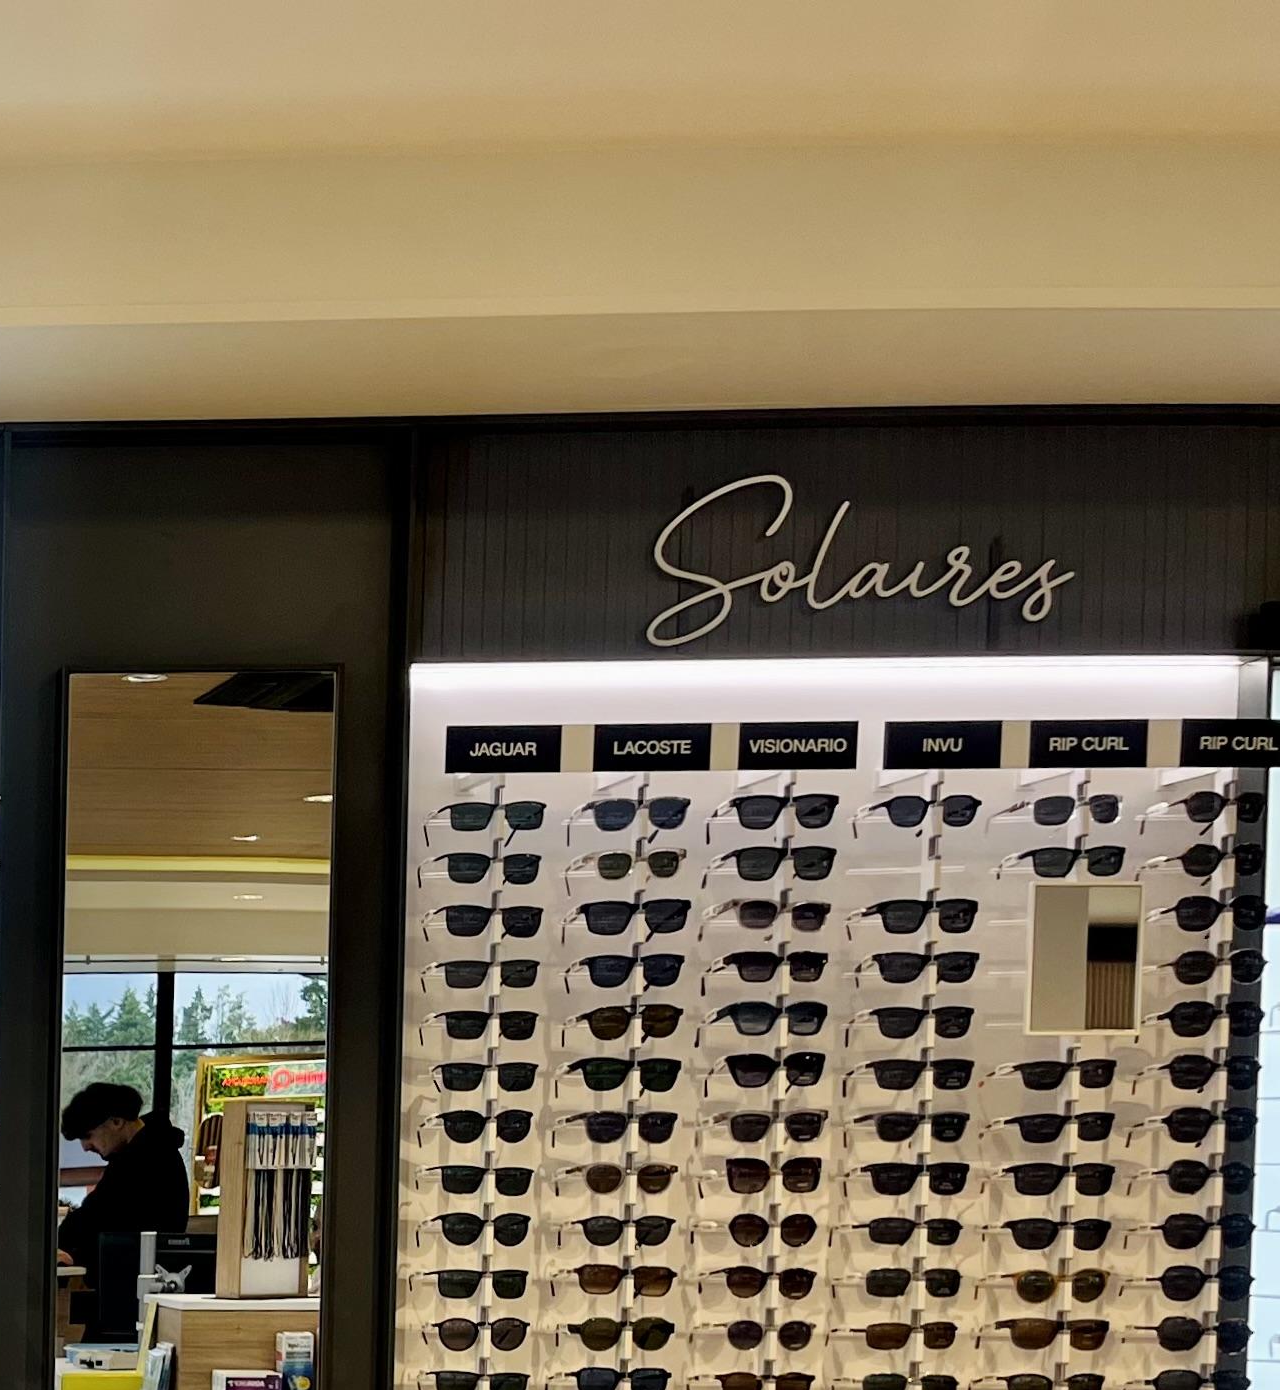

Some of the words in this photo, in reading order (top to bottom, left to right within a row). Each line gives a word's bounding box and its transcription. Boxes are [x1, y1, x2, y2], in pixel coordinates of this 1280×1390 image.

[646, 474, 1075, 647] Solaires
[469, 741, 537, 757] JAGUAR
[613, 739, 692, 755] LACOSTE
[749, 738, 847, 754] VISIONARIO
[922, 738, 963, 752] INVU
[1049, 737, 1078, 751] RIP
[1081, 736, 1129, 751] CURL
[1200, 736, 1228, 750] RIP
[1232, 736, 1279, 751] CURL
